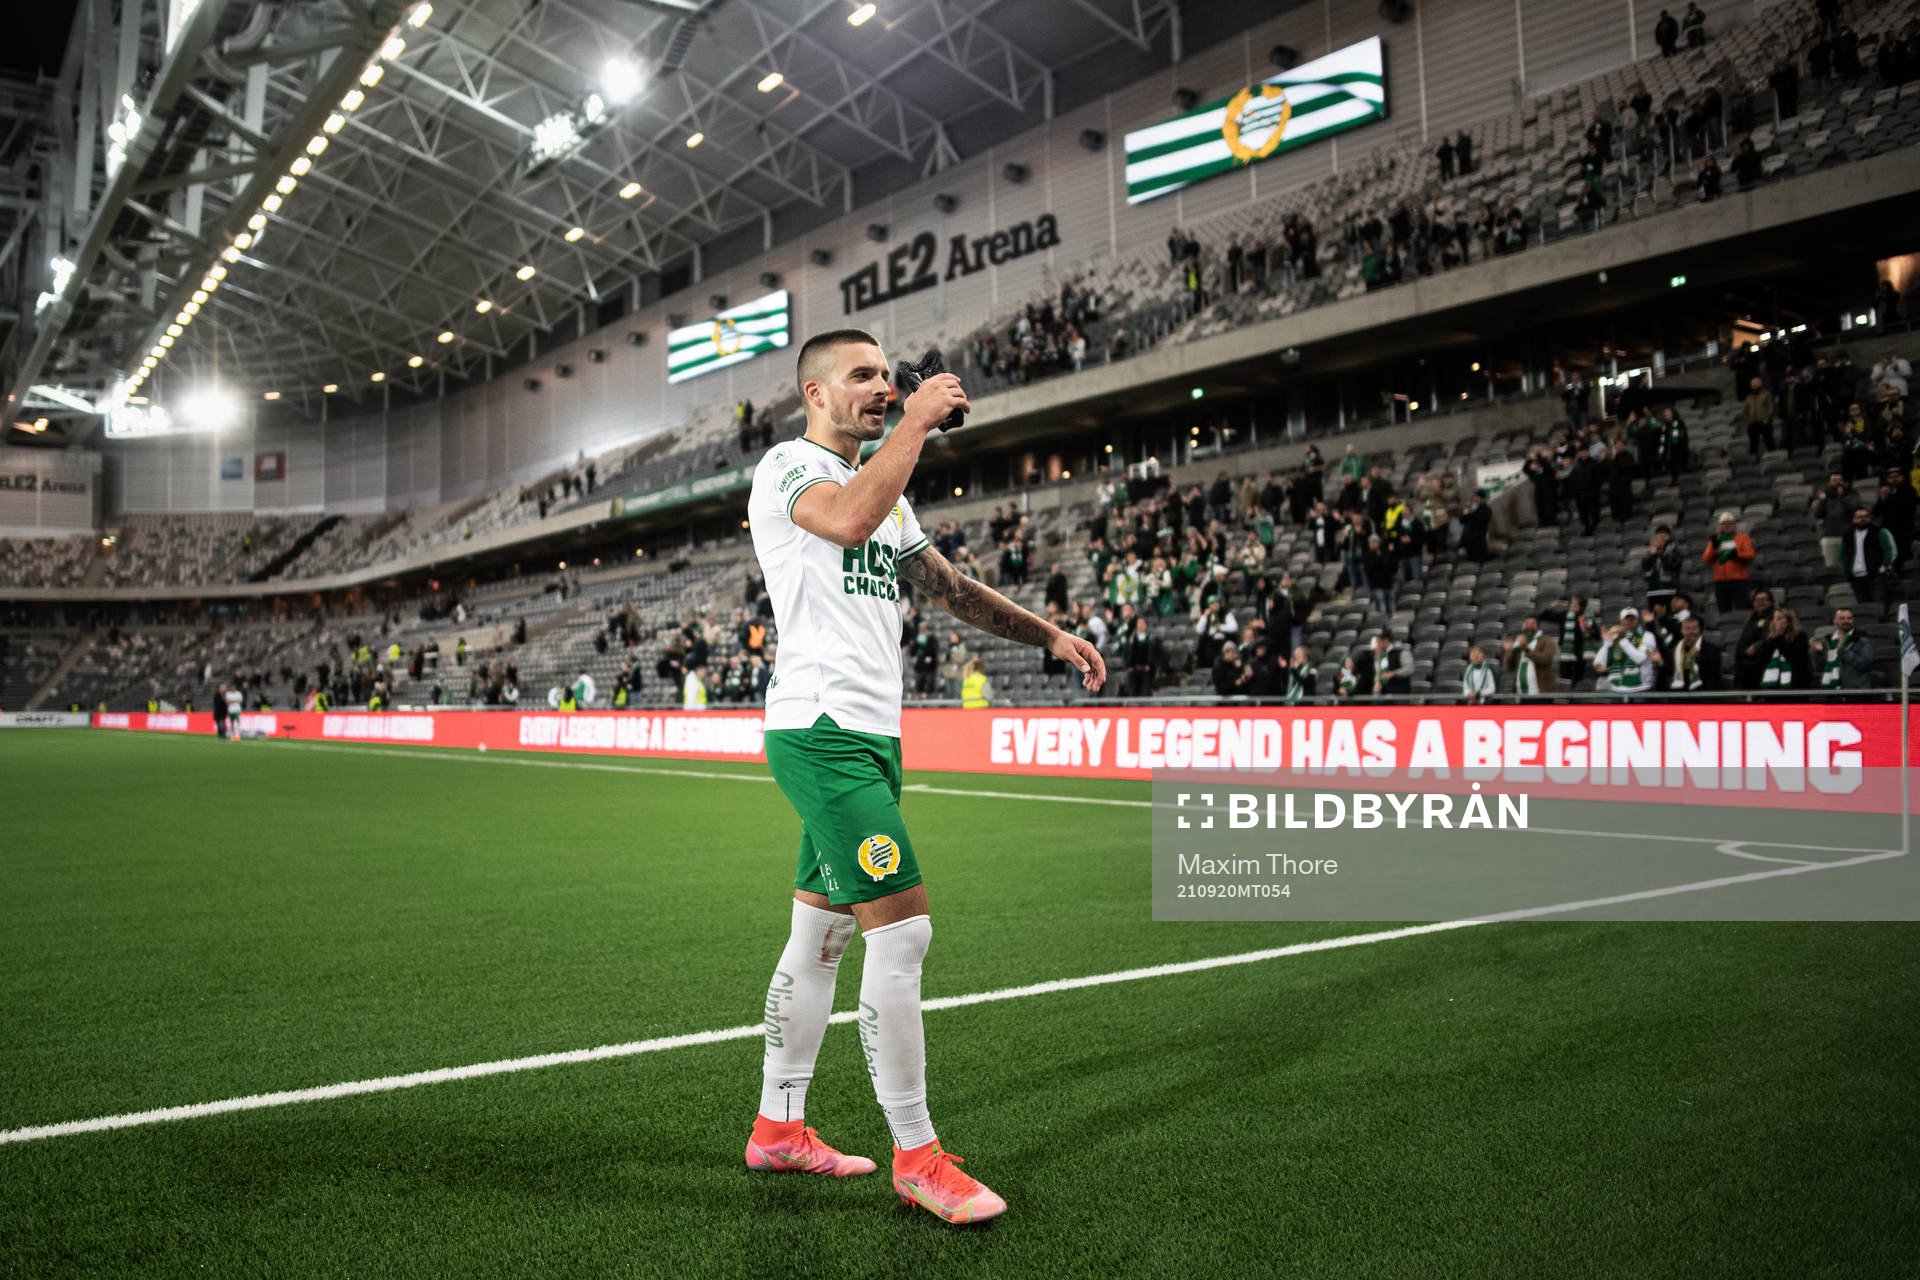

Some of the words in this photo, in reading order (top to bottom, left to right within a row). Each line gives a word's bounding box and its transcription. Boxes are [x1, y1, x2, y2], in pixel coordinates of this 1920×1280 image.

[840, 231, 938, 315] TELE2
[944, 213, 1061, 282] Arena
[779, 464, 807, 493] UNIBET
[990, 717, 1110, 766] EVERY
[1115, 718, 1282, 773] LEGEND
[1291, 719, 1397, 778] HAS
[1408, 719, 1451, 780] A
[1463, 719, 1863, 795] BEGINNING
[766, 970, 794, 1049] Clinton
